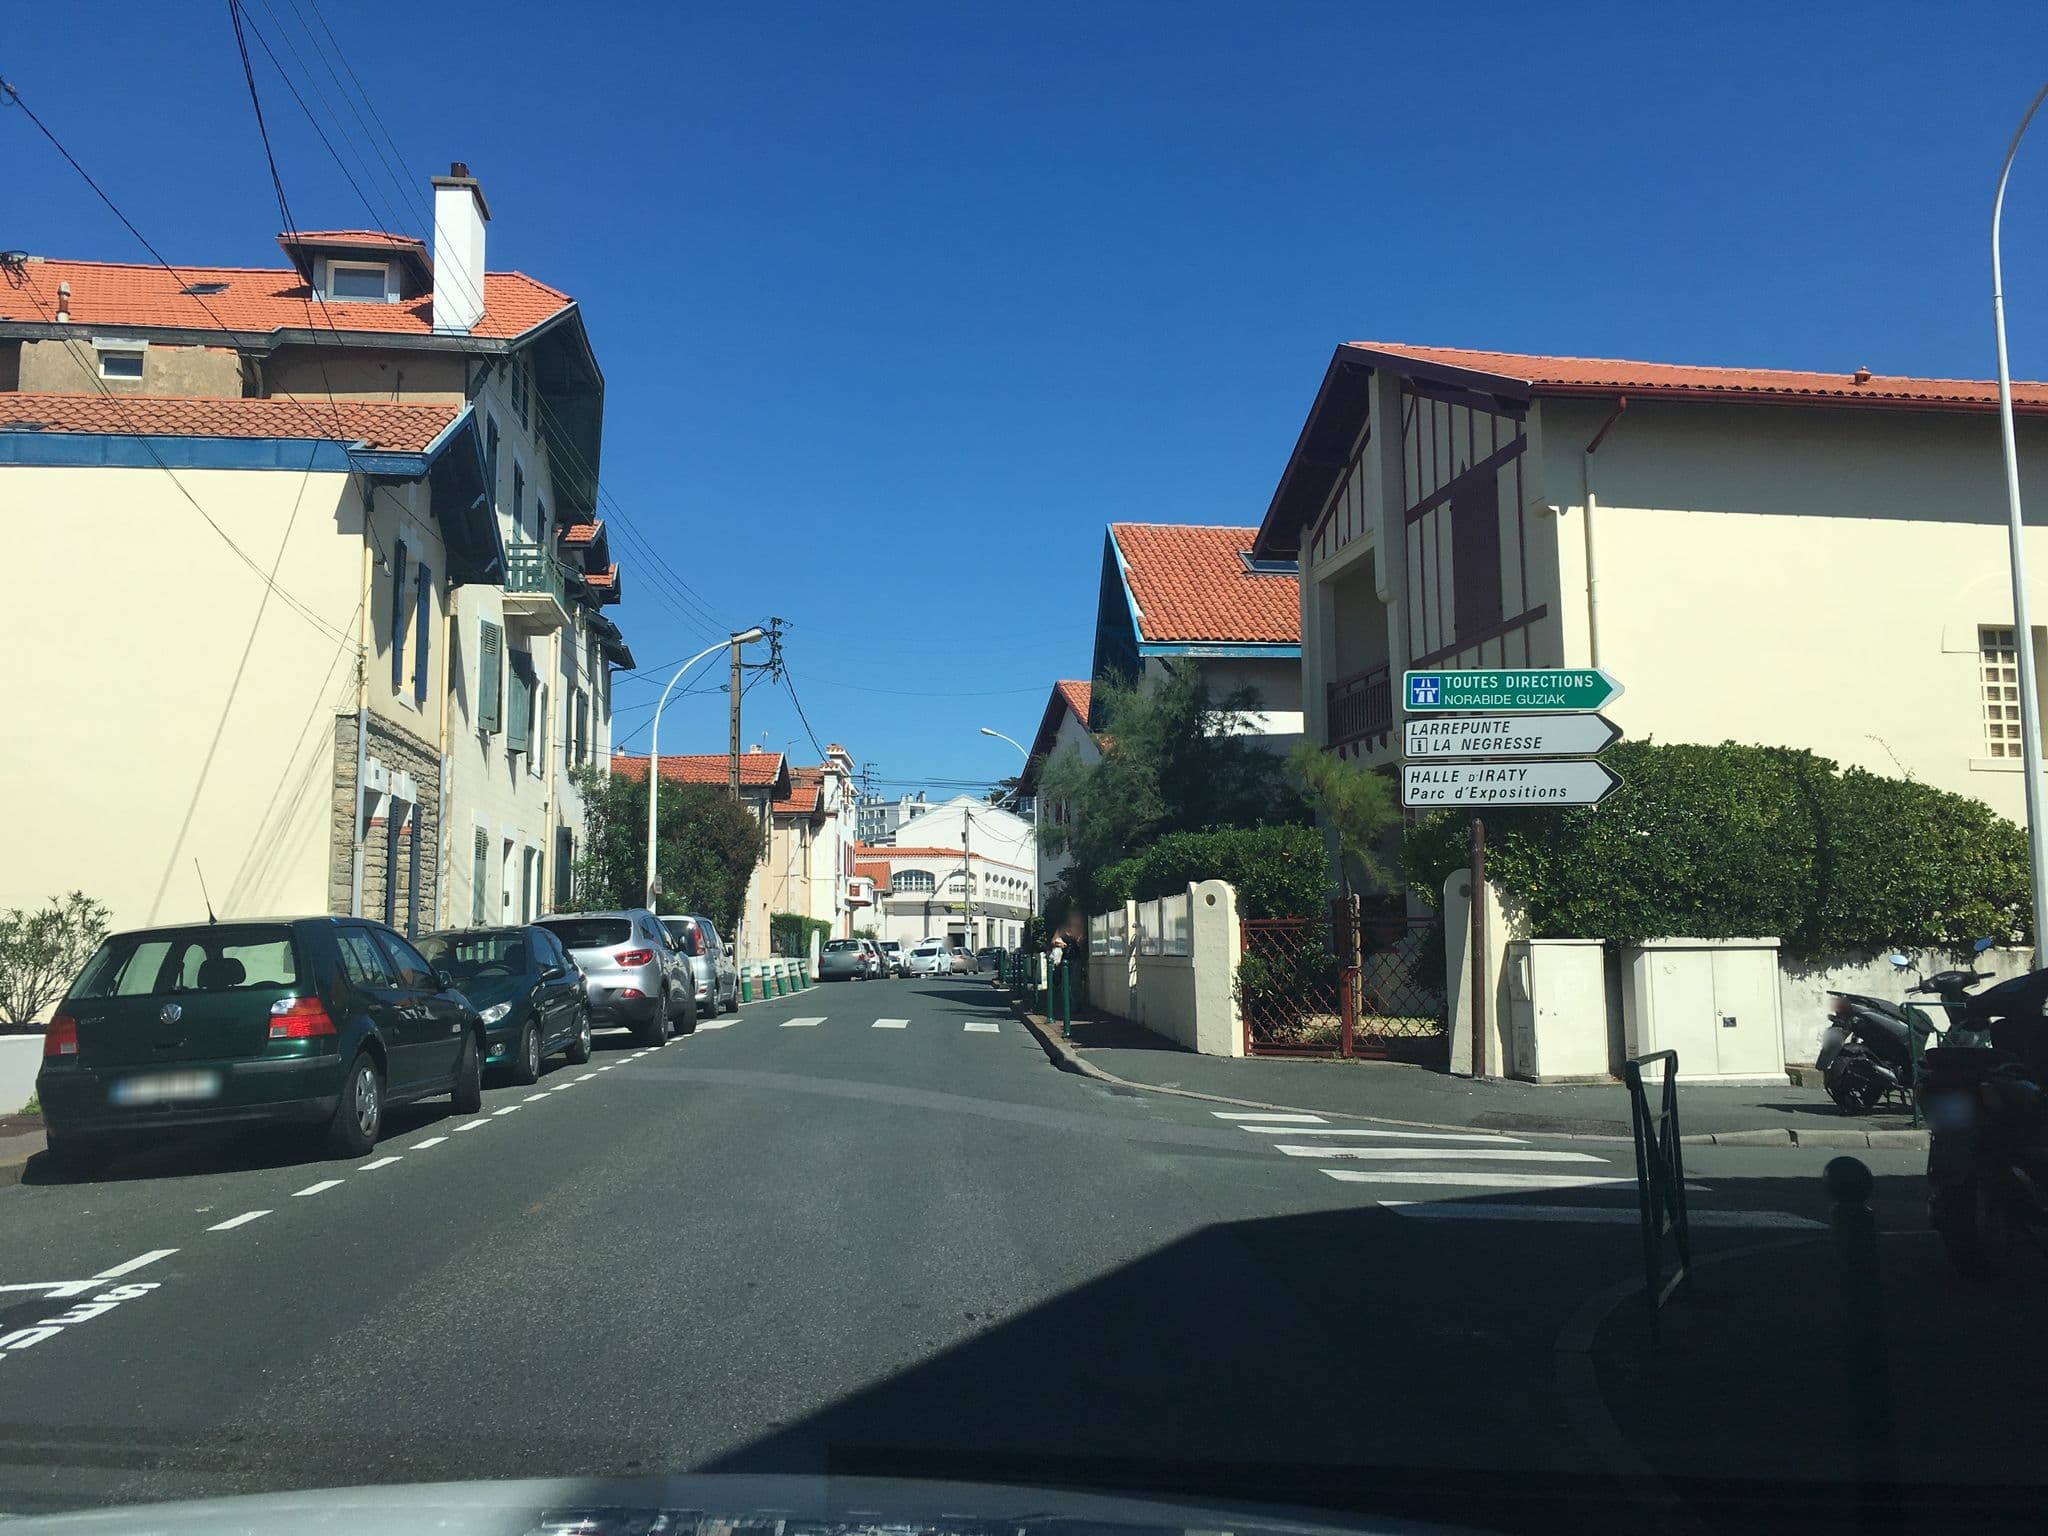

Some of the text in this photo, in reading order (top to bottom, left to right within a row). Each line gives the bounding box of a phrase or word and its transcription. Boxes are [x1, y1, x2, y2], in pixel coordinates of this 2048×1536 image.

[1445, 675, 1594, 689] TOUTES DIRECTIONS
[1444, 694, 1566, 705] NORABIDE GUZIAK
[1411, 721, 1510, 736] LARREPUNTE
[1433, 739, 1451, 751] LA
[1461, 737, 1542, 751] NEGRESSE
[1410, 771, 1460, 783] HALLE
[1410, 785, 1567, 801] Parc d'Expositions
[0, 1283, 161, 1359] UES
